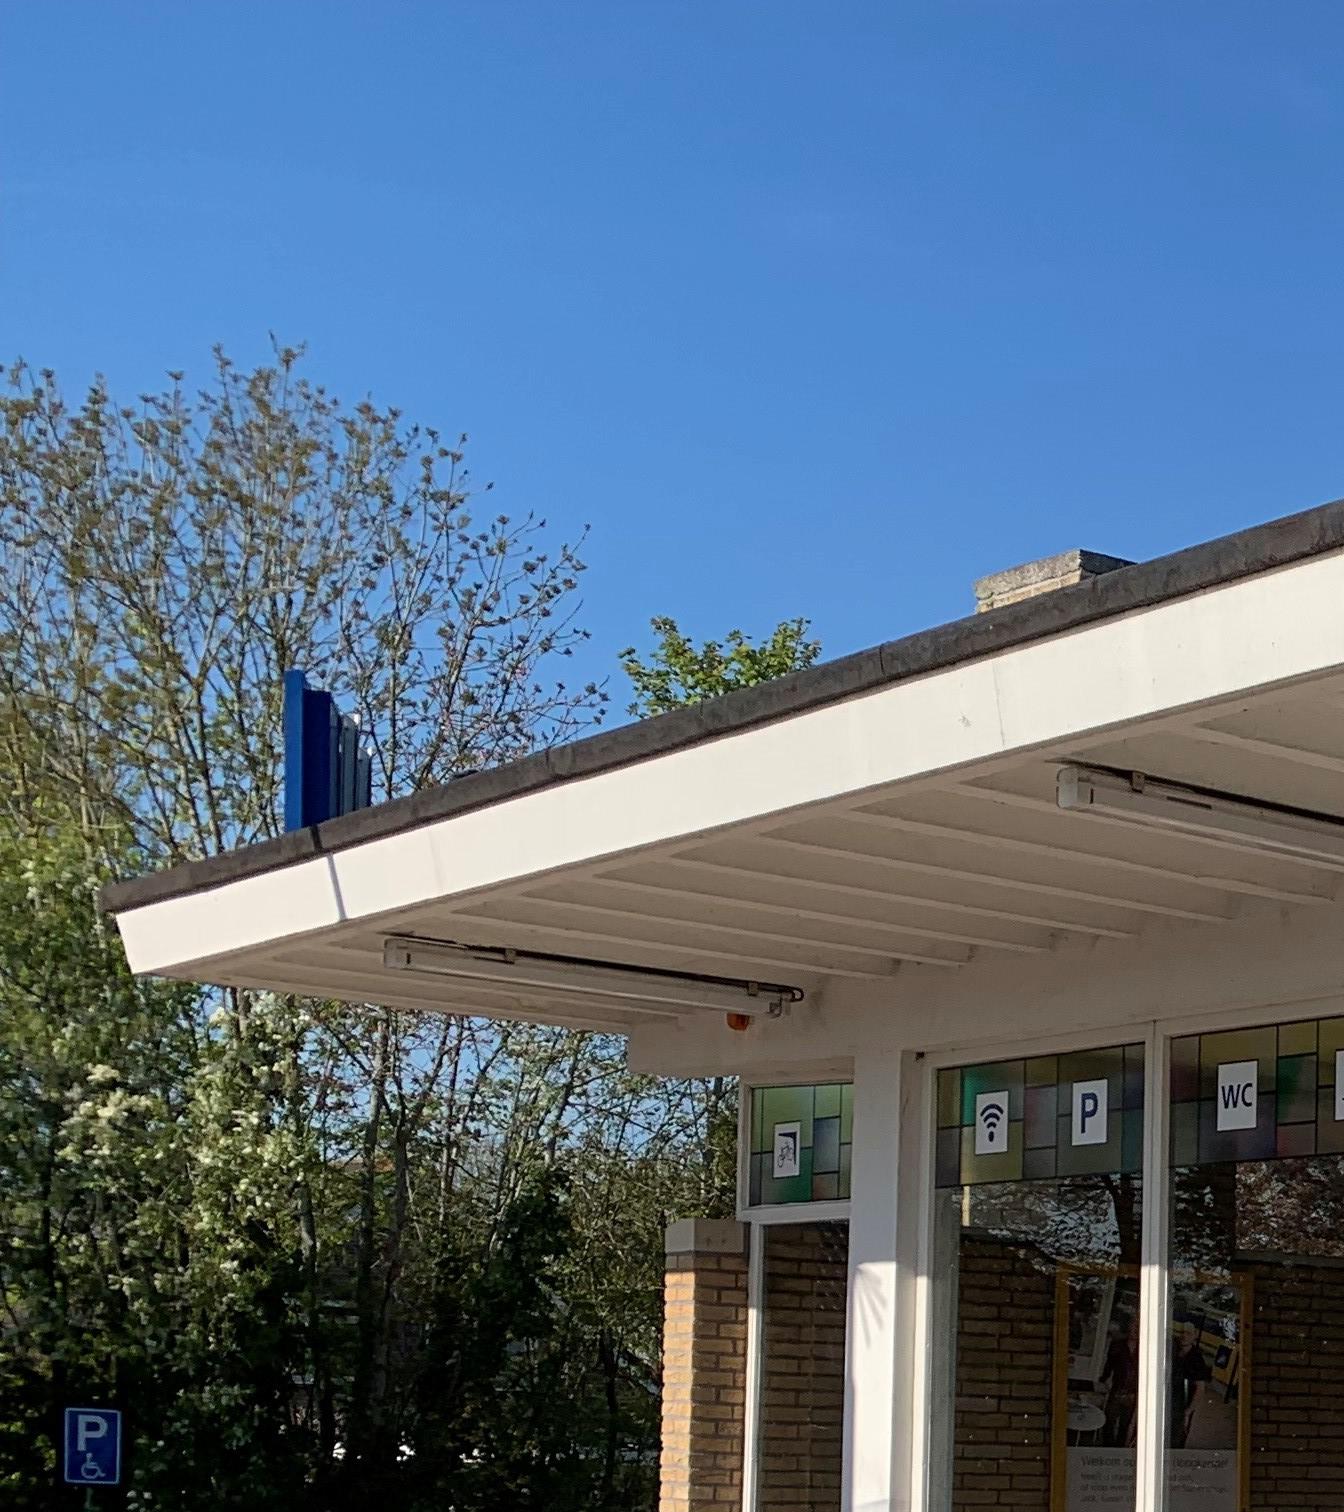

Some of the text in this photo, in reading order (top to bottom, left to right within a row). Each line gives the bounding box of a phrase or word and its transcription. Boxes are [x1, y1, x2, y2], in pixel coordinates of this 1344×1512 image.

[1080, 1093, 1099, 1135] P
[1221, 1082, 1254, 1111] WC
[77, 1414, 109, 1452] P
